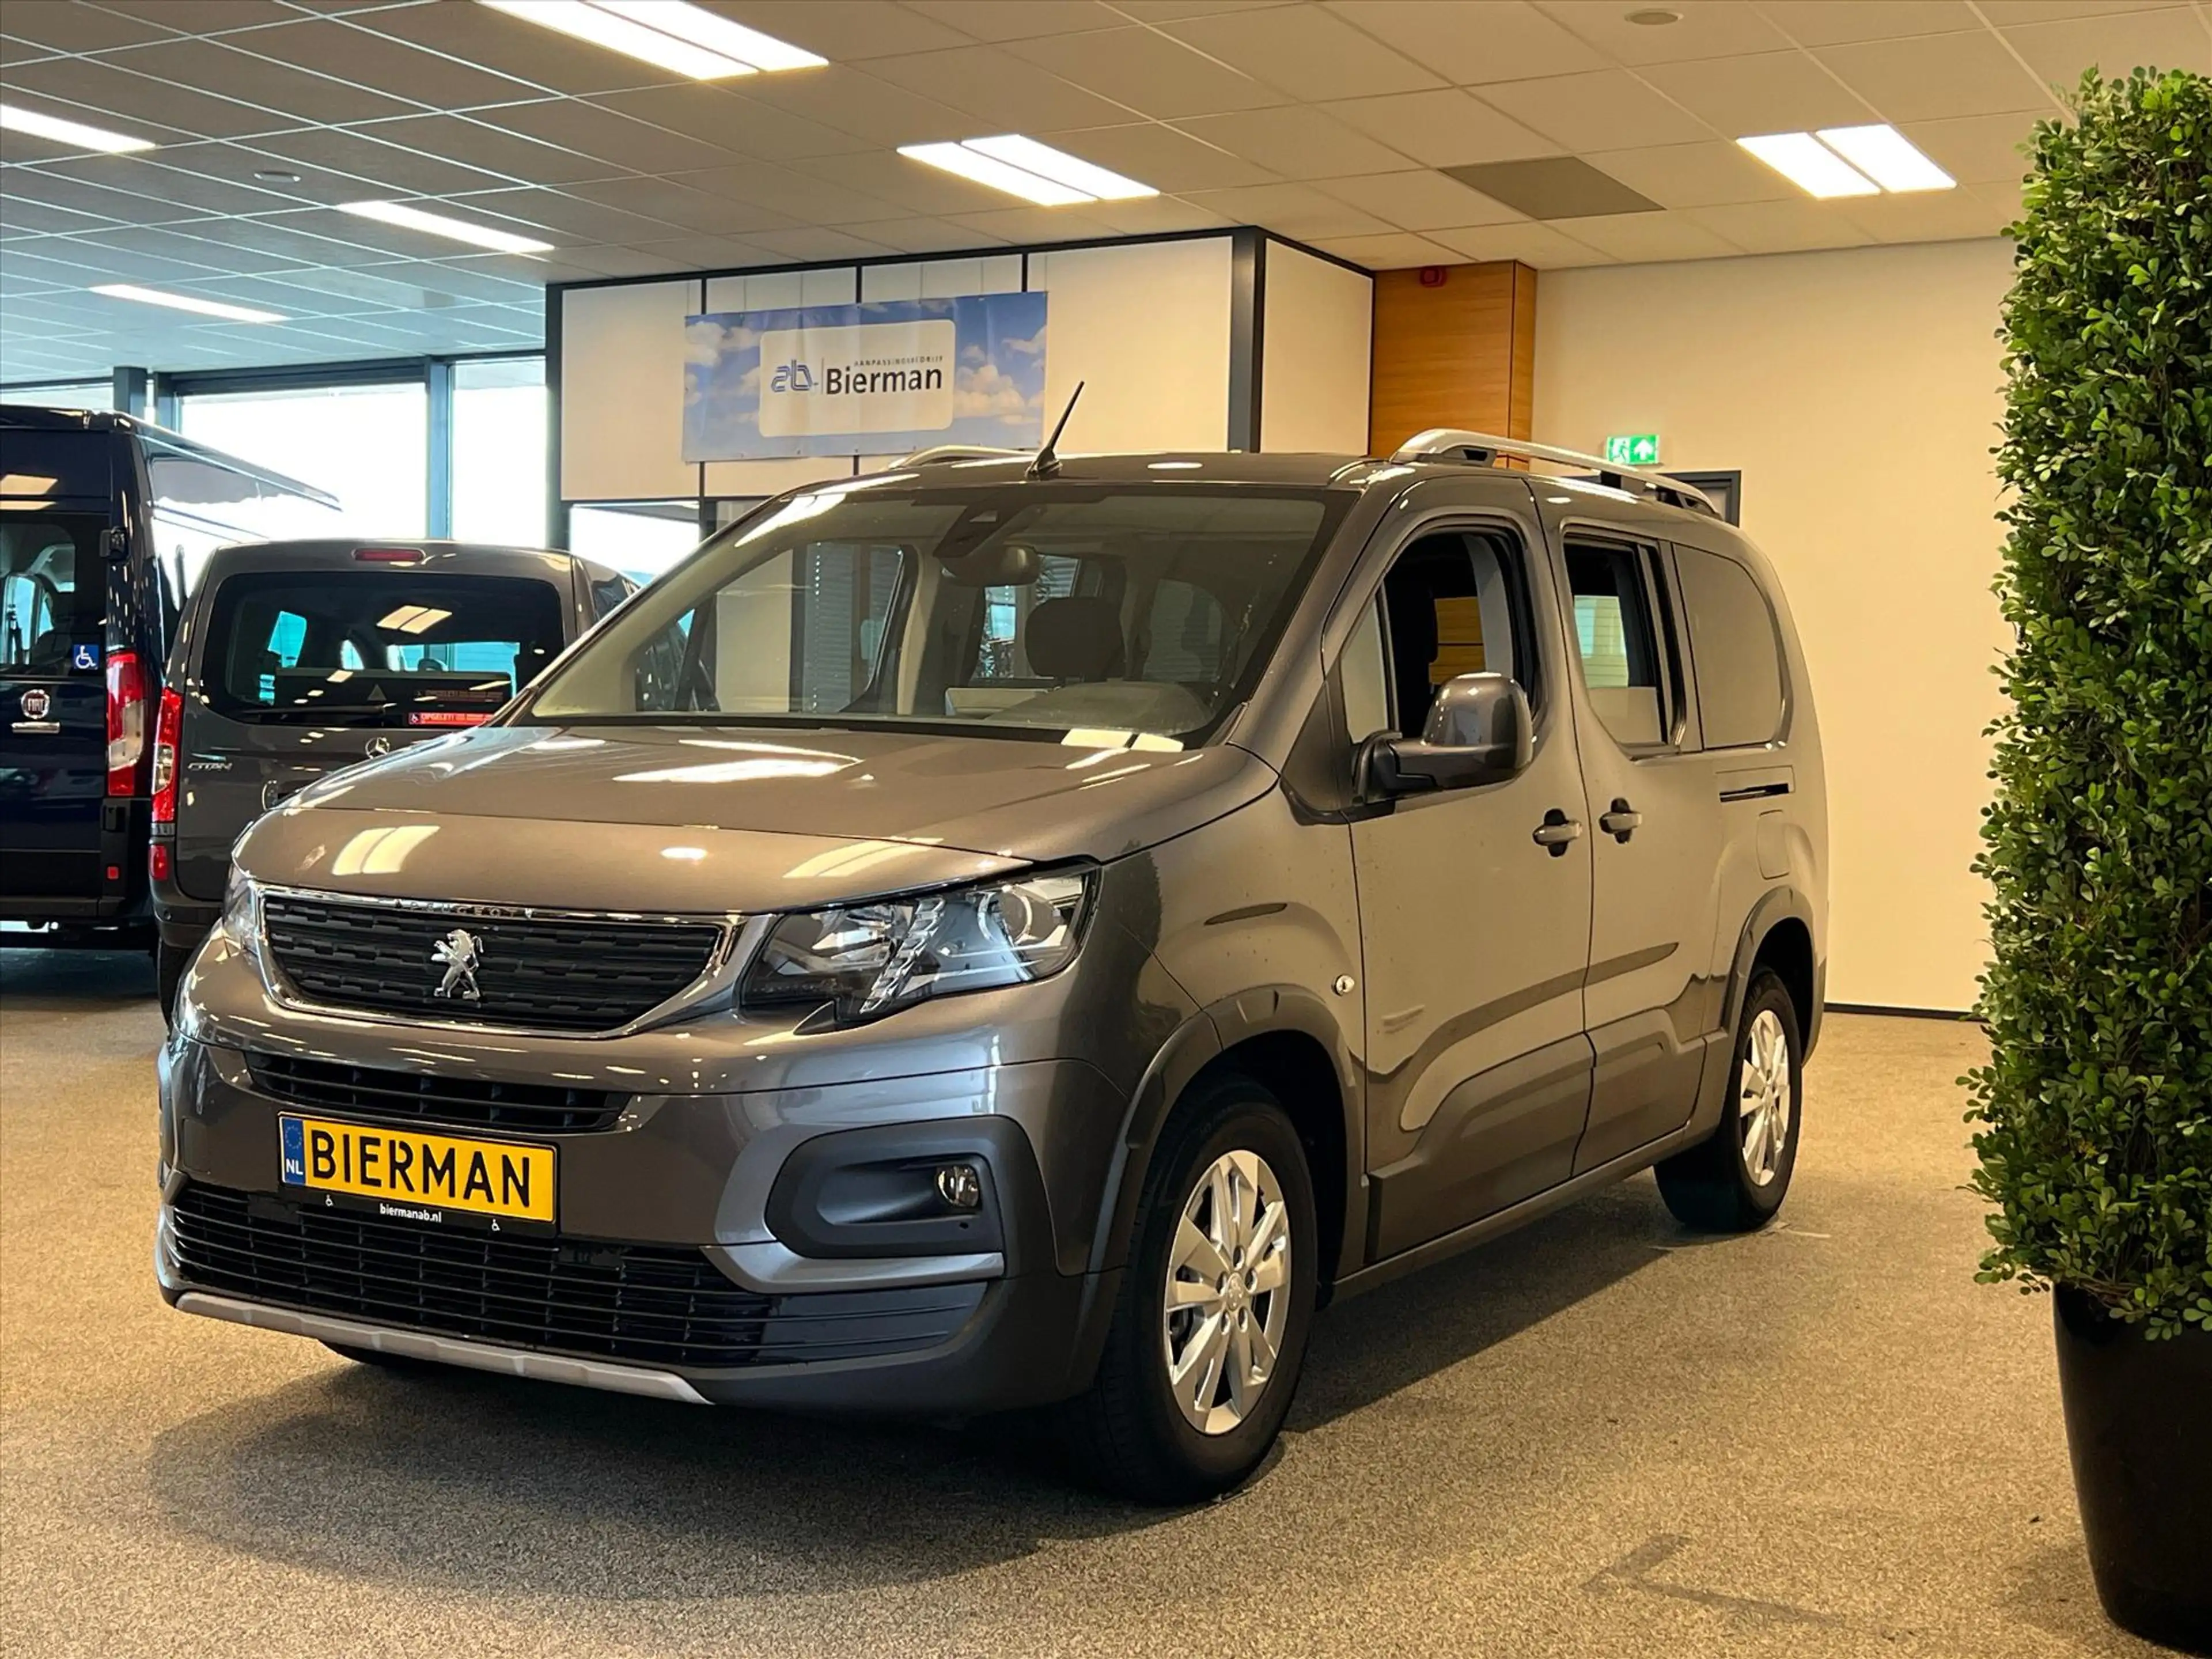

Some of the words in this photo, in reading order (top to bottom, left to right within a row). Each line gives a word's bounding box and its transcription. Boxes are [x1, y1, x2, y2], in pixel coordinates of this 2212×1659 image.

[826, 366, 942, 395] Bierman
[28, 698, 44, 711] FIAT
[188, 762, 232, 771] CITAN
[411, 902, 515, 918] PEUGEOT
[286, 1158, 304, 1175] NL
[311, 1129, 530, 1207] BIERMAN
[380, 1203, 442, 1222] biermanab.nl
